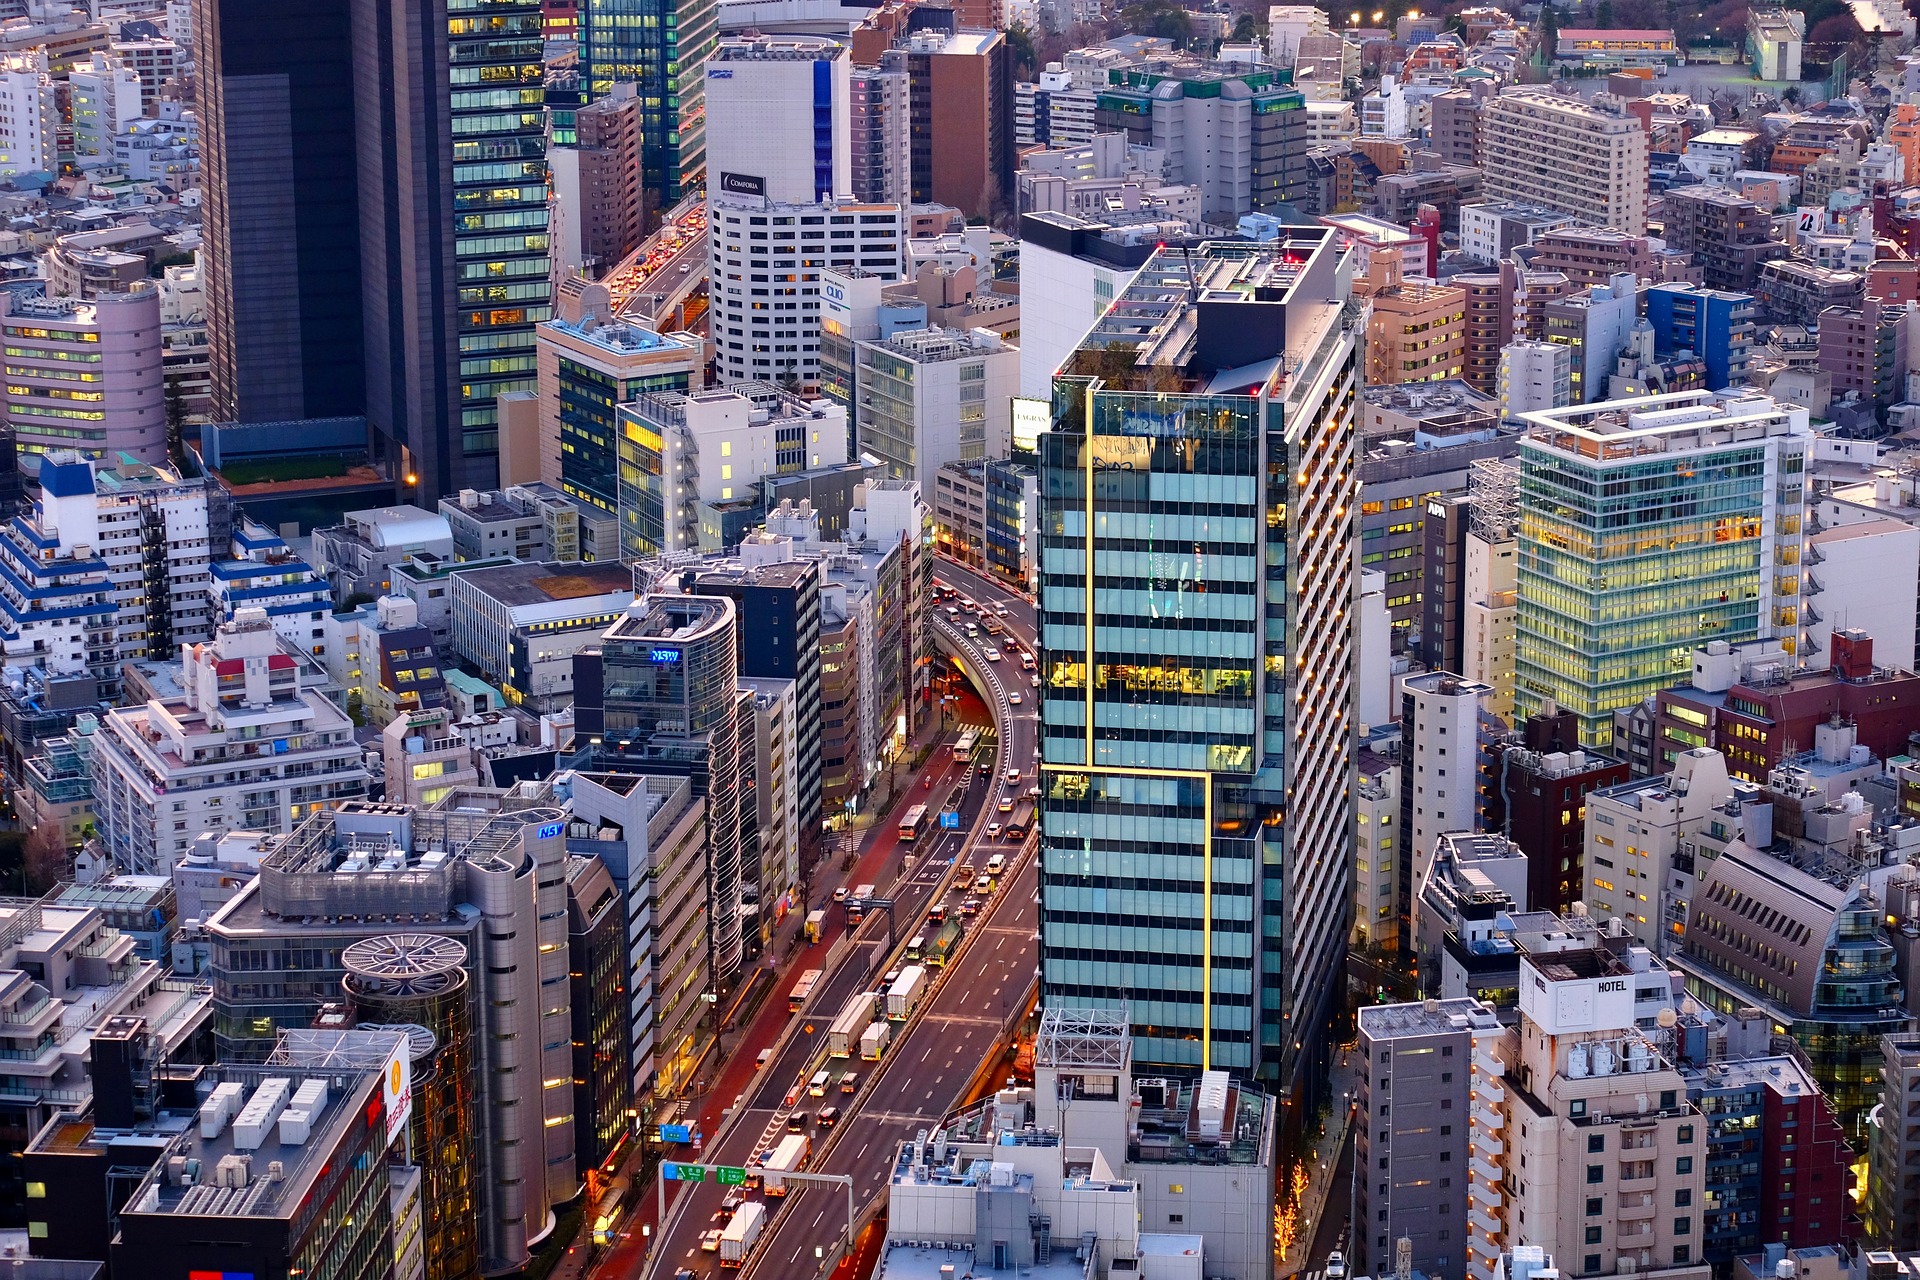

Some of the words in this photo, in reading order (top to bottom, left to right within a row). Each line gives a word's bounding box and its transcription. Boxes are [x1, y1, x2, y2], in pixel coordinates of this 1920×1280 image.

[730, 179, 759, 190] COMFORIA
[1427, 501, 1446, 519] APA
[652, 650, 679, 662] NSW
[538, 823, 564, 839] NSW
[1598, 981, 1627, 993] HOTEL
